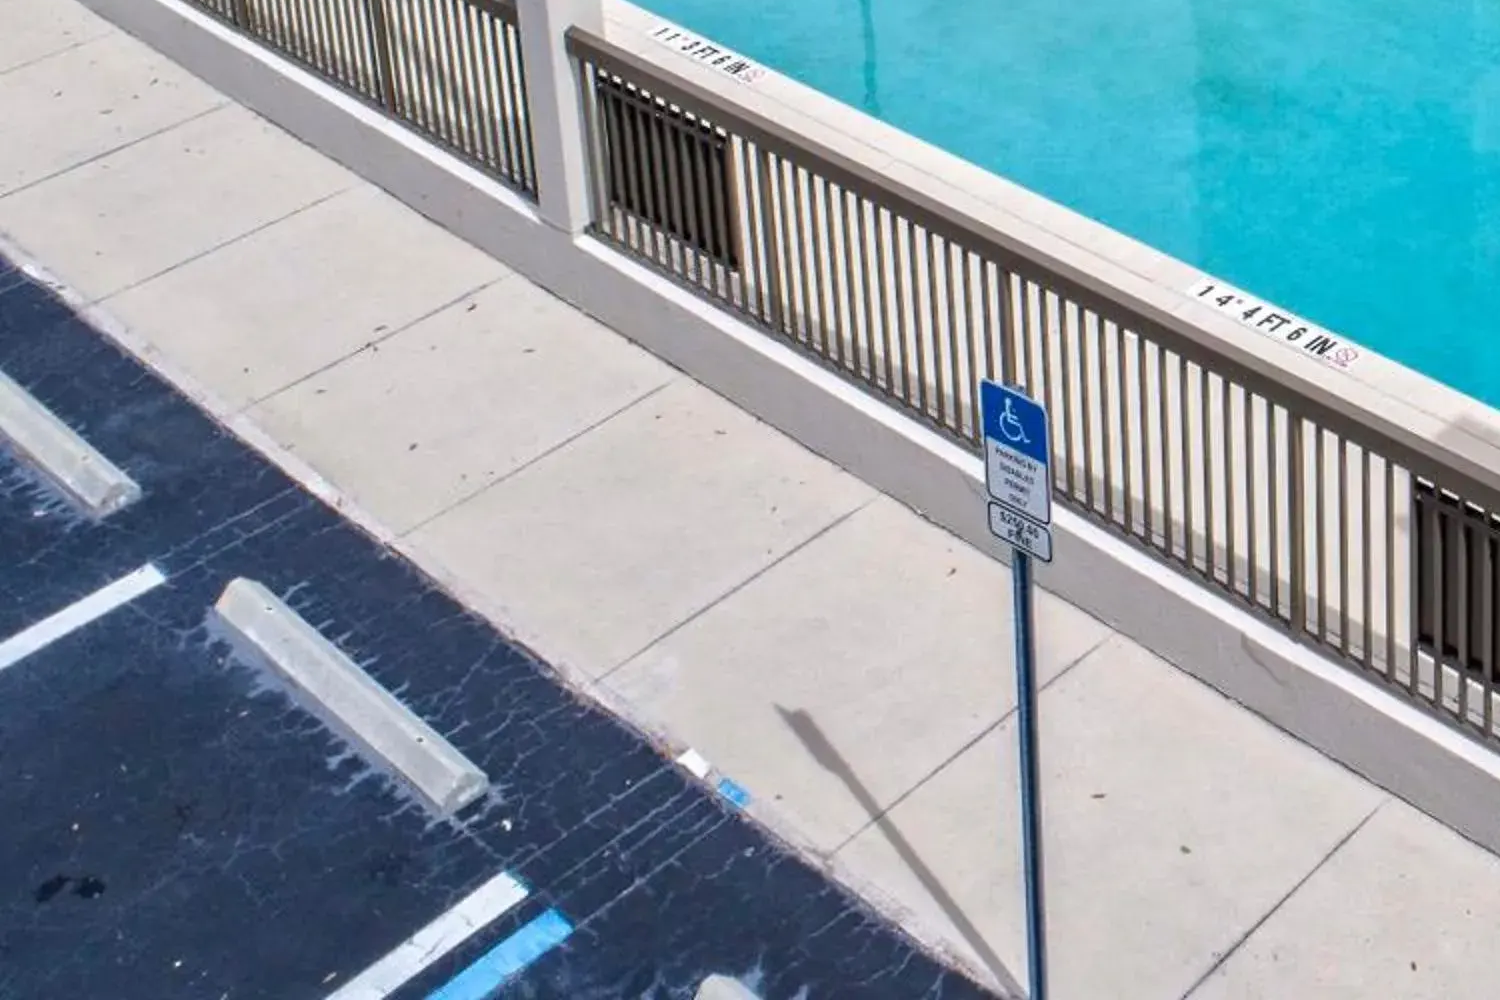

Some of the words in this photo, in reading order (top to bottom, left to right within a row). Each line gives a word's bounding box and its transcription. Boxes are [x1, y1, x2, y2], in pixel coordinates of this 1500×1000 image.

[692, 46, 720, 59] FT
[1256, 313, 1291, 333] FT
[1286, 327, 1307, 341] 6
[1304, 335, 1337, 355] IN
